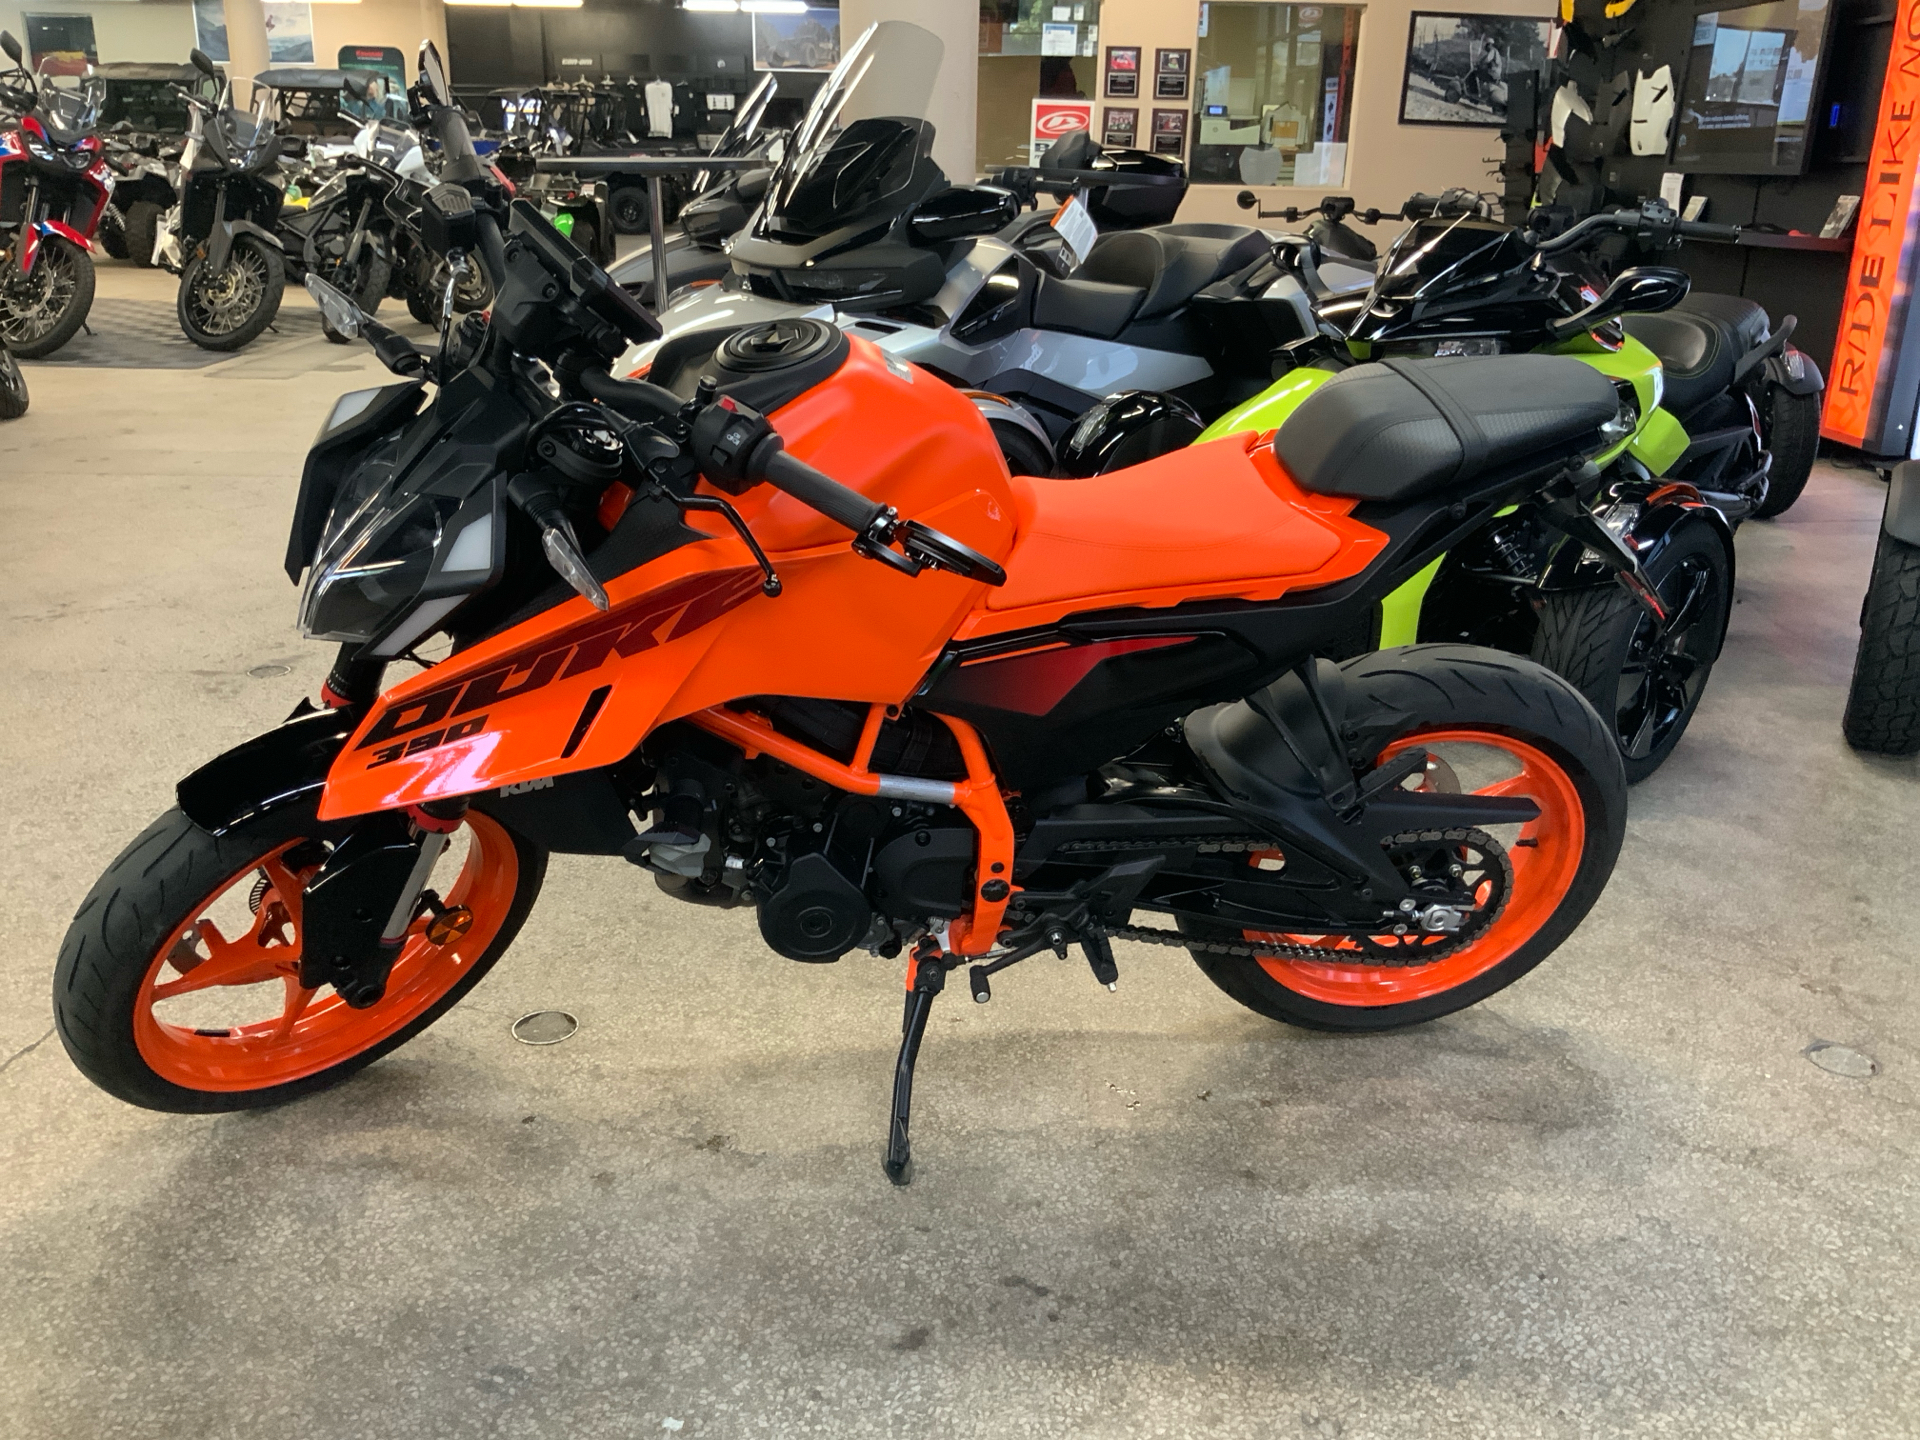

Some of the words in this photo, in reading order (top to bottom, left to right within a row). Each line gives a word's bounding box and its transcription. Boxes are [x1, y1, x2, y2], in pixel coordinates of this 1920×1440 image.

[1839, 255, 1885, 396] RIDE
[1869, 101, 1915, 234] LIKE
[354, 566, 765, 751] DUKE
[366, 714, 489, 770] 390
